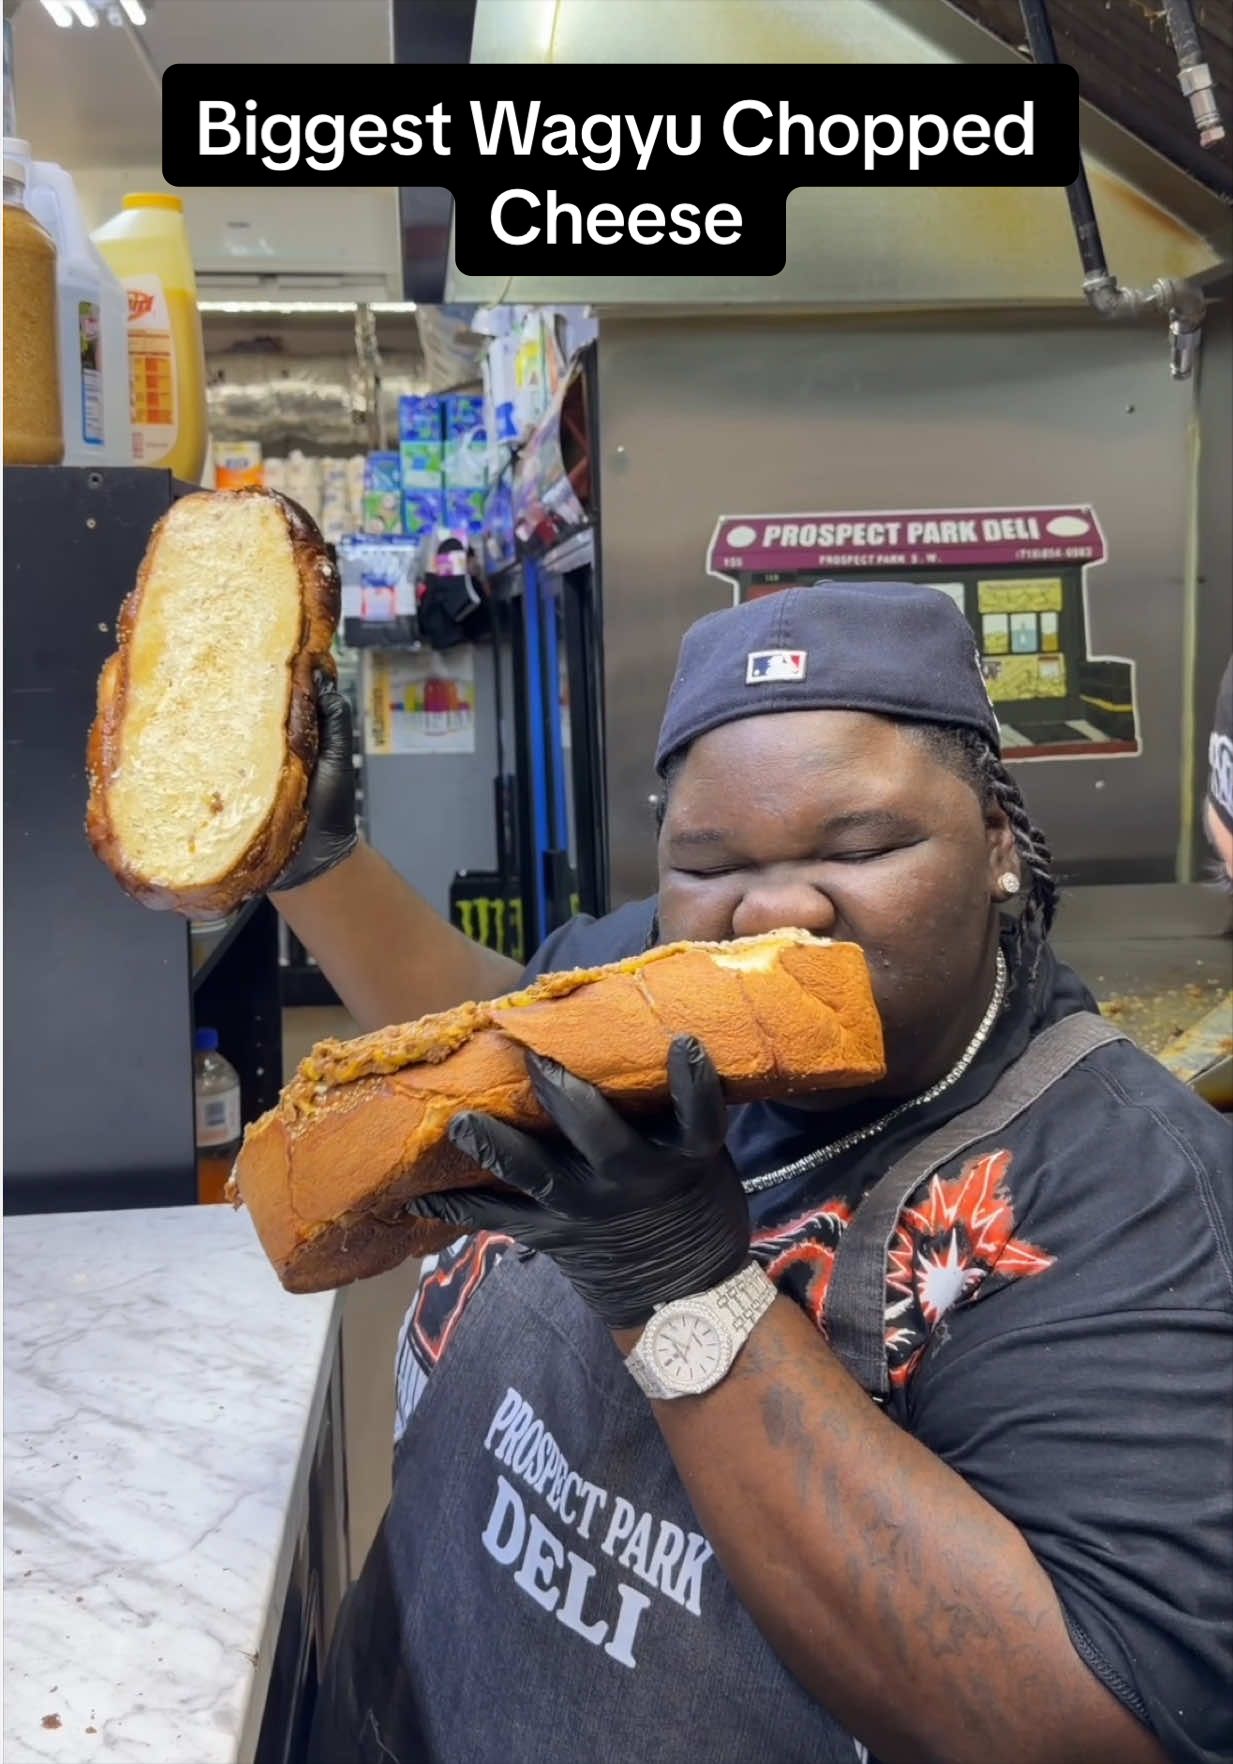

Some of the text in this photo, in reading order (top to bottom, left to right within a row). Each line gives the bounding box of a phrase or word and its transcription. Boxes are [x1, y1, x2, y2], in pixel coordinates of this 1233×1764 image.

[762, 517, 1041, 547] PROSPECT PARK DELI
[819, 555, 875, 566] PROSPECT
[876, 554, 906, 565] PARK
[484, 1387, 714, 1616] PROSPECT PARK
[481, 1475, 651, 1668] DELI
